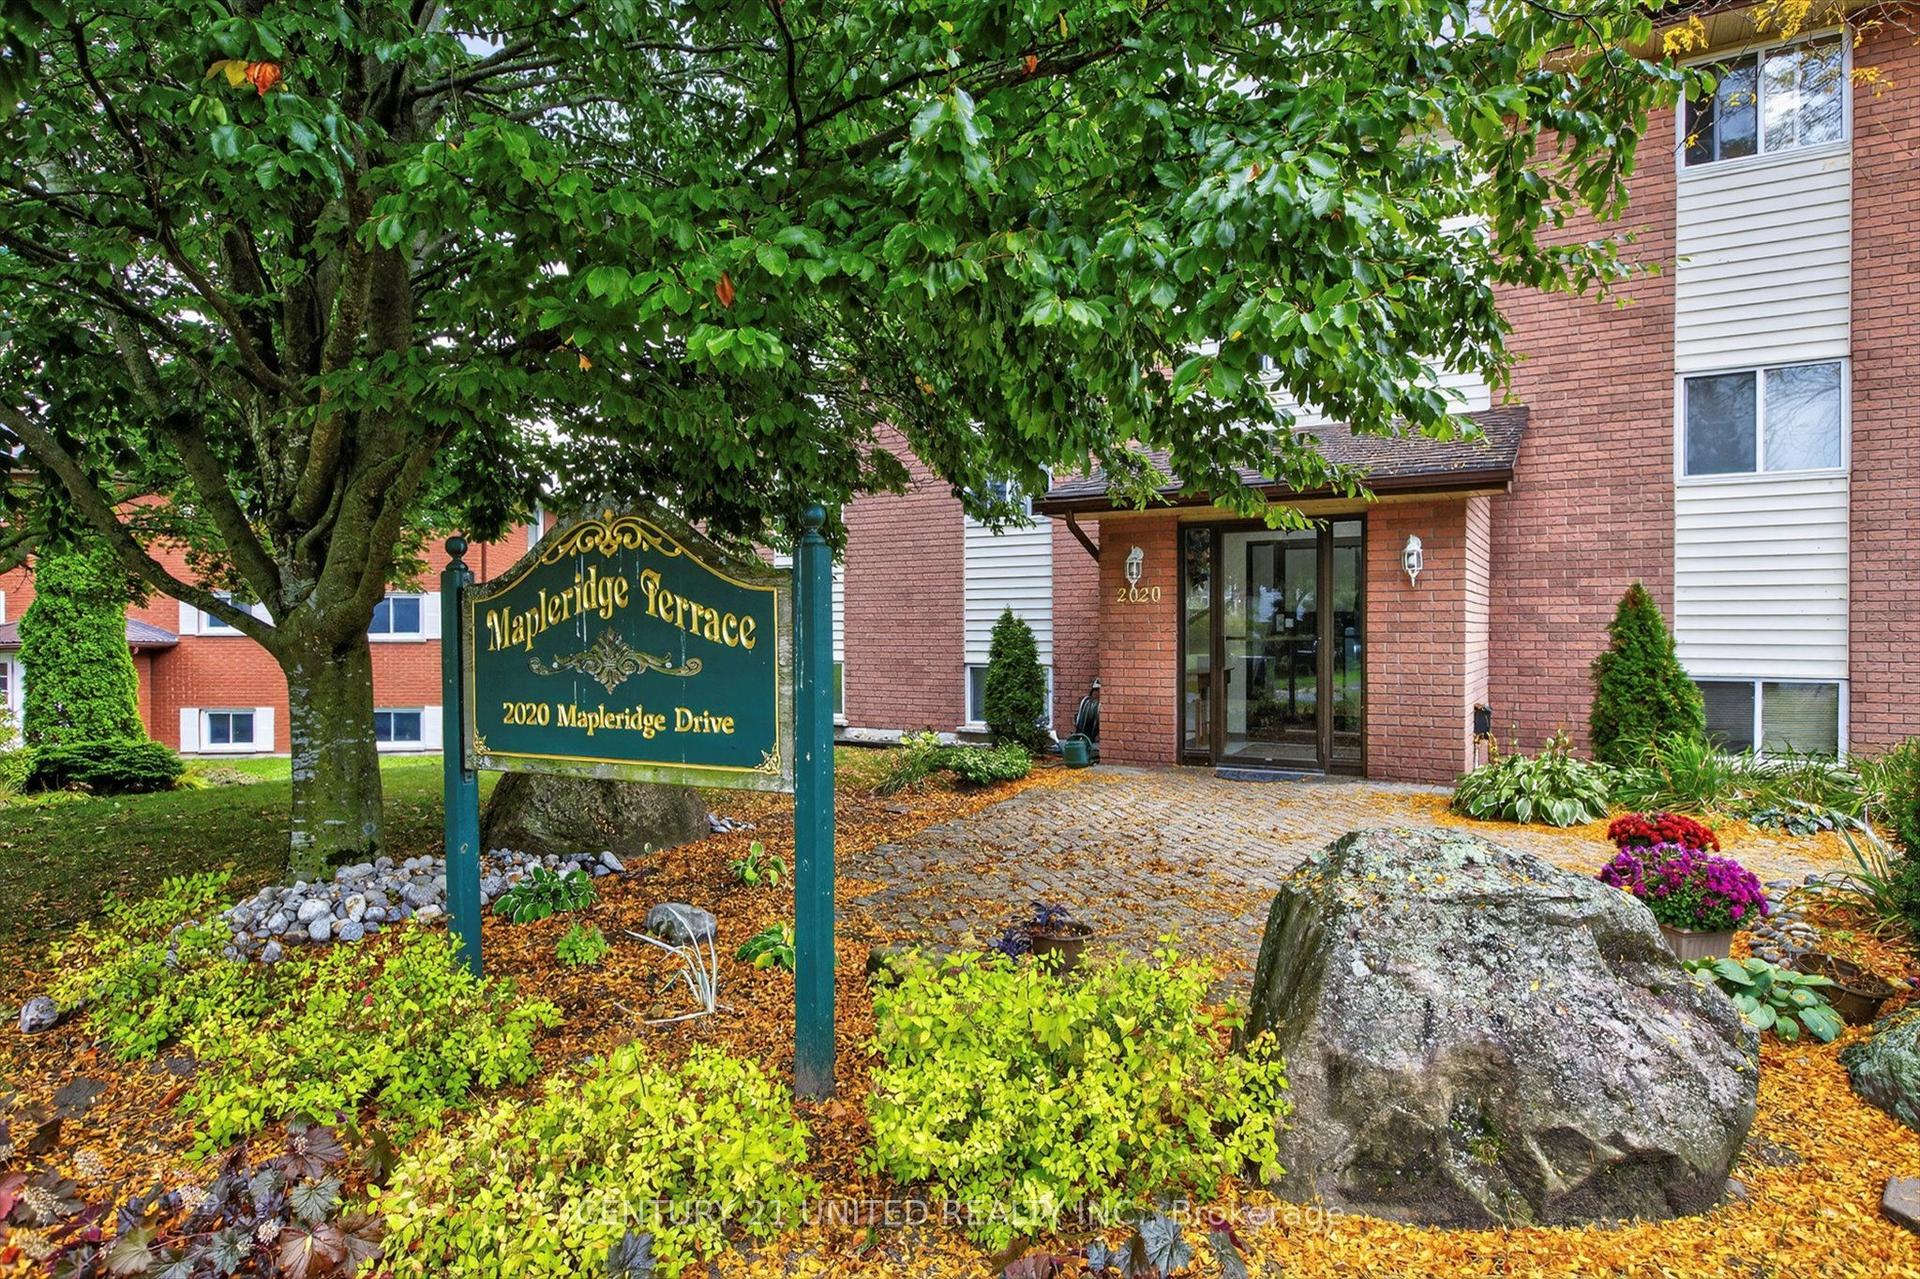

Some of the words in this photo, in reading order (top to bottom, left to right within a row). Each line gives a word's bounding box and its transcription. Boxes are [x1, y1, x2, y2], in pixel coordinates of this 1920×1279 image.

[487, 565, 629, 652] Mapleridge
[641, 568, 757, 649] Terrace
[1116, 586, 1161, 603] 2020
[503, 702, 550, 726] 2020
[557, 703, 666, 739] Mapleridge
[674, 706, 735, 735] Drive
